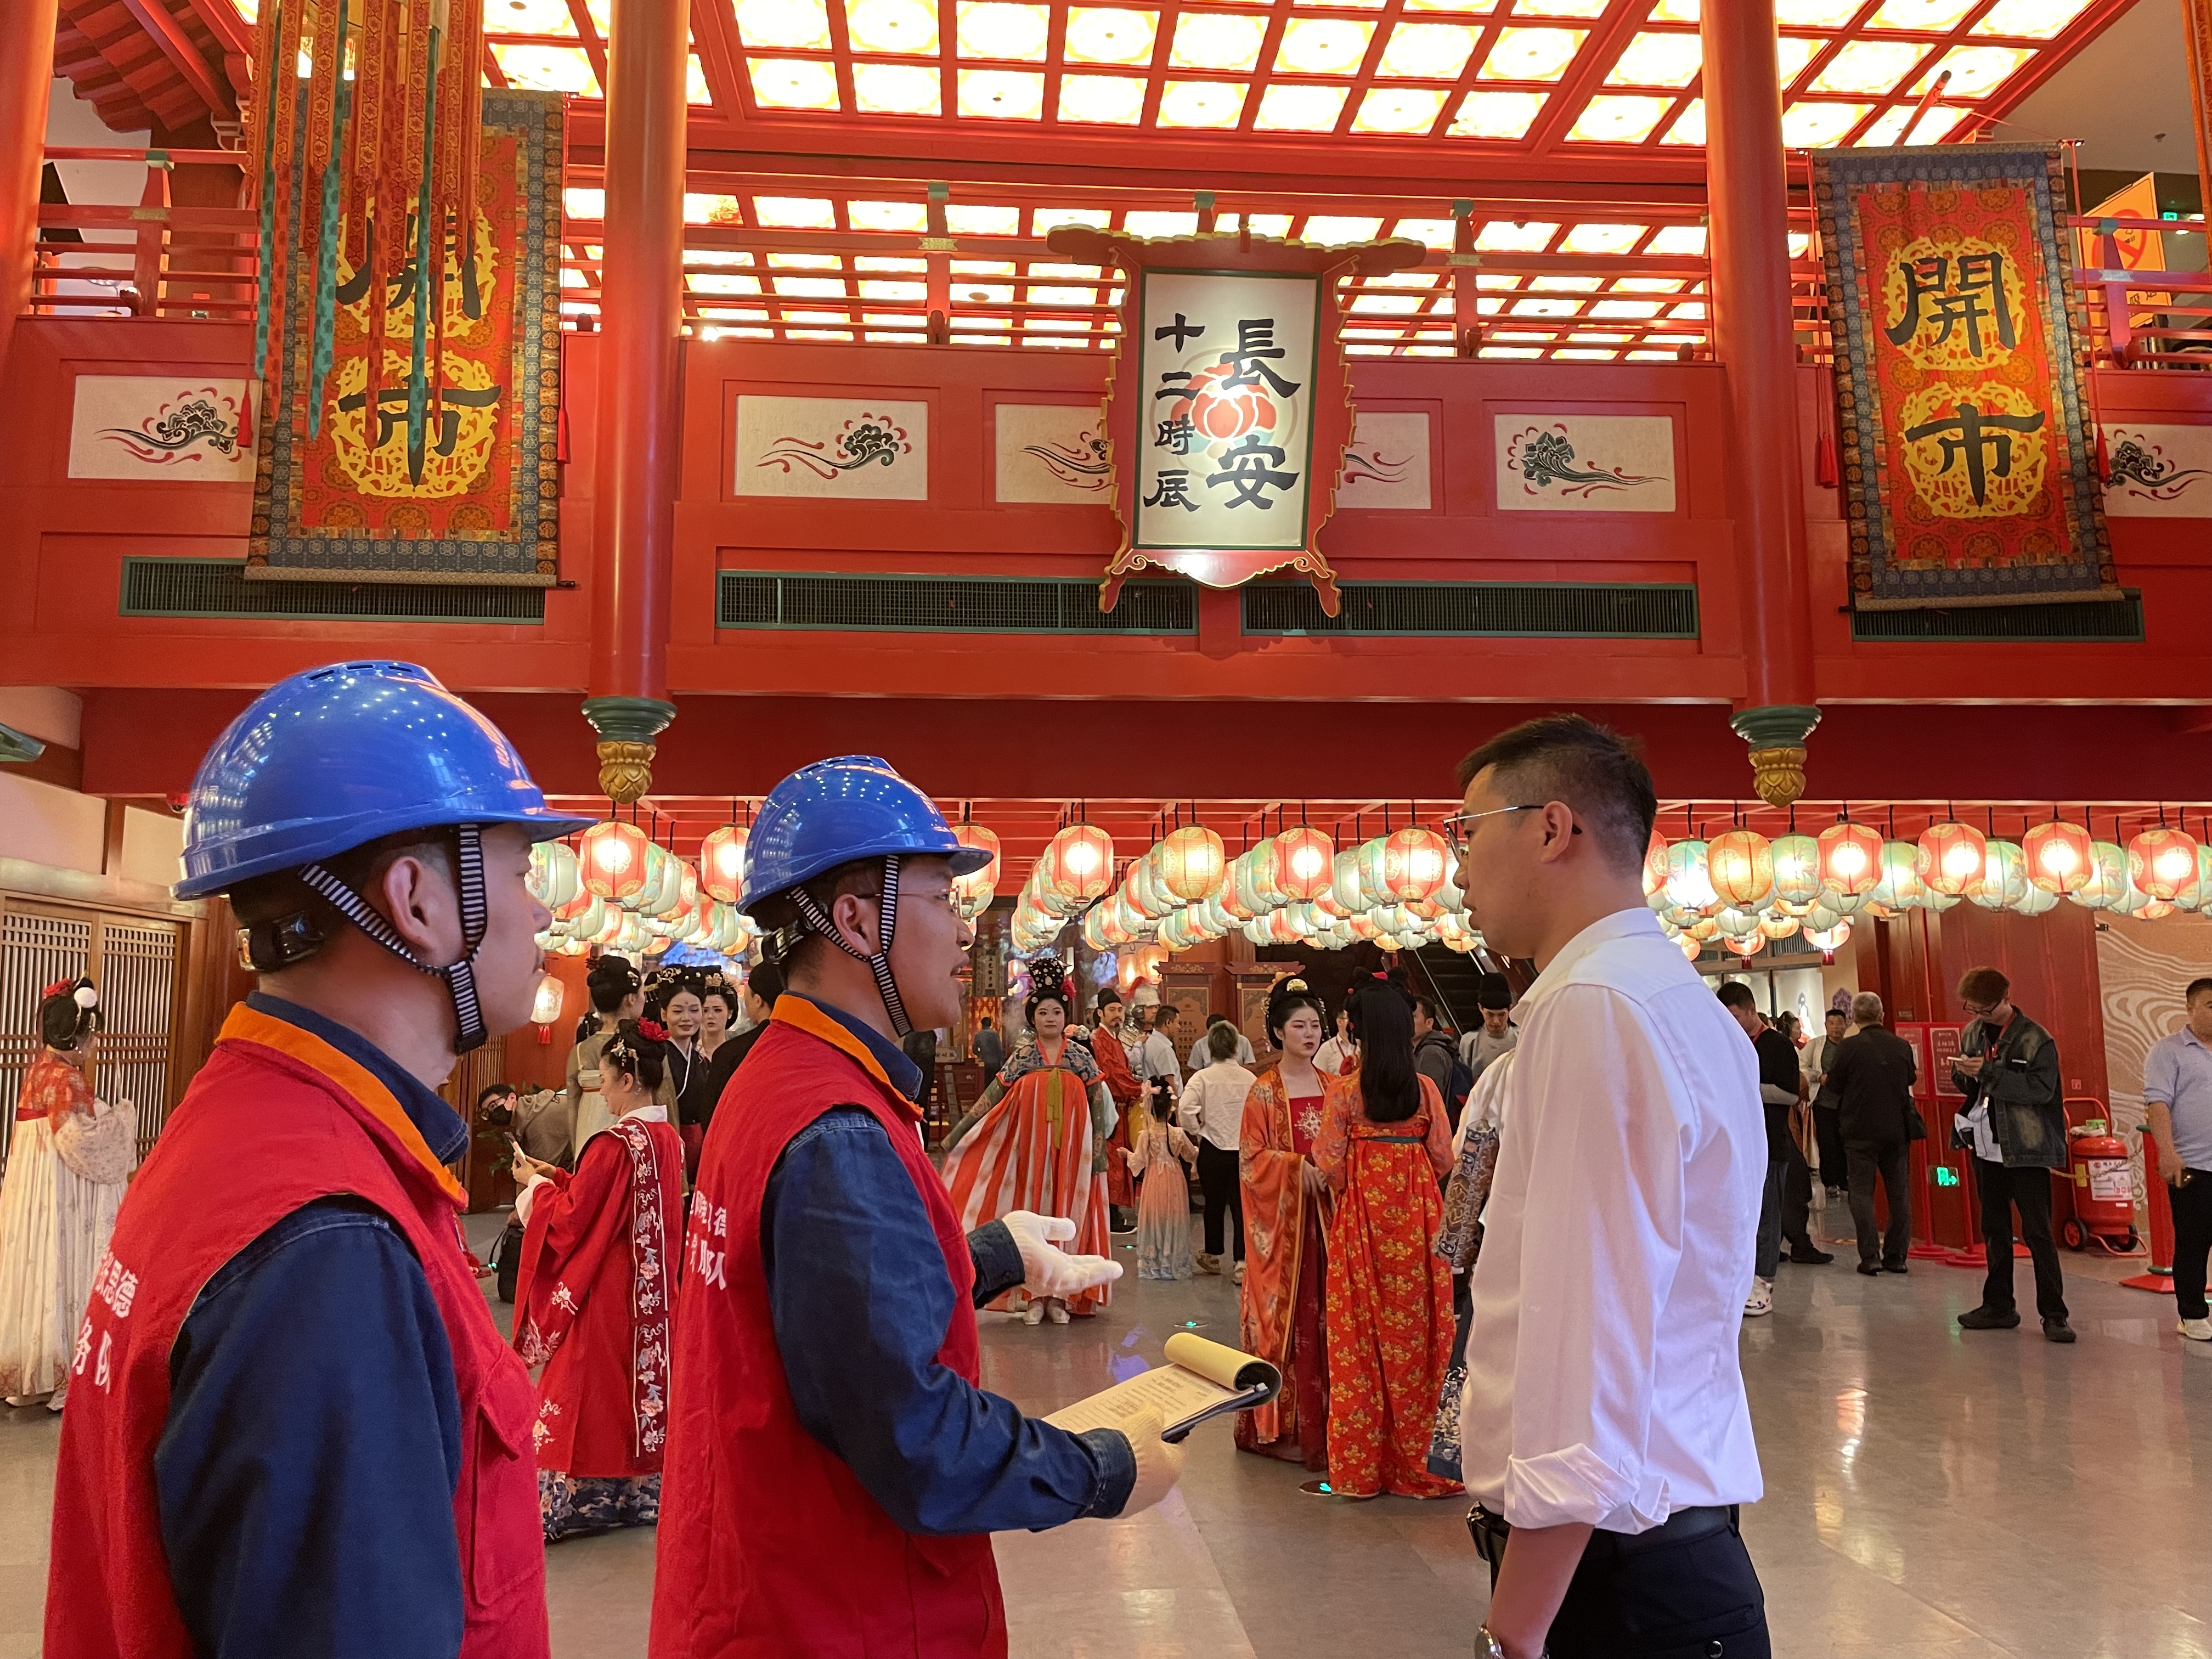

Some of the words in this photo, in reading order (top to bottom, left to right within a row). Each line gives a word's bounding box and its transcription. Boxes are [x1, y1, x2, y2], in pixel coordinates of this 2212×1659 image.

[1143, 313, 1205, 512] 十二時辰
[1207, 318, 1301, 510] 長安
[1884, 251, 2045, 508] 開市
